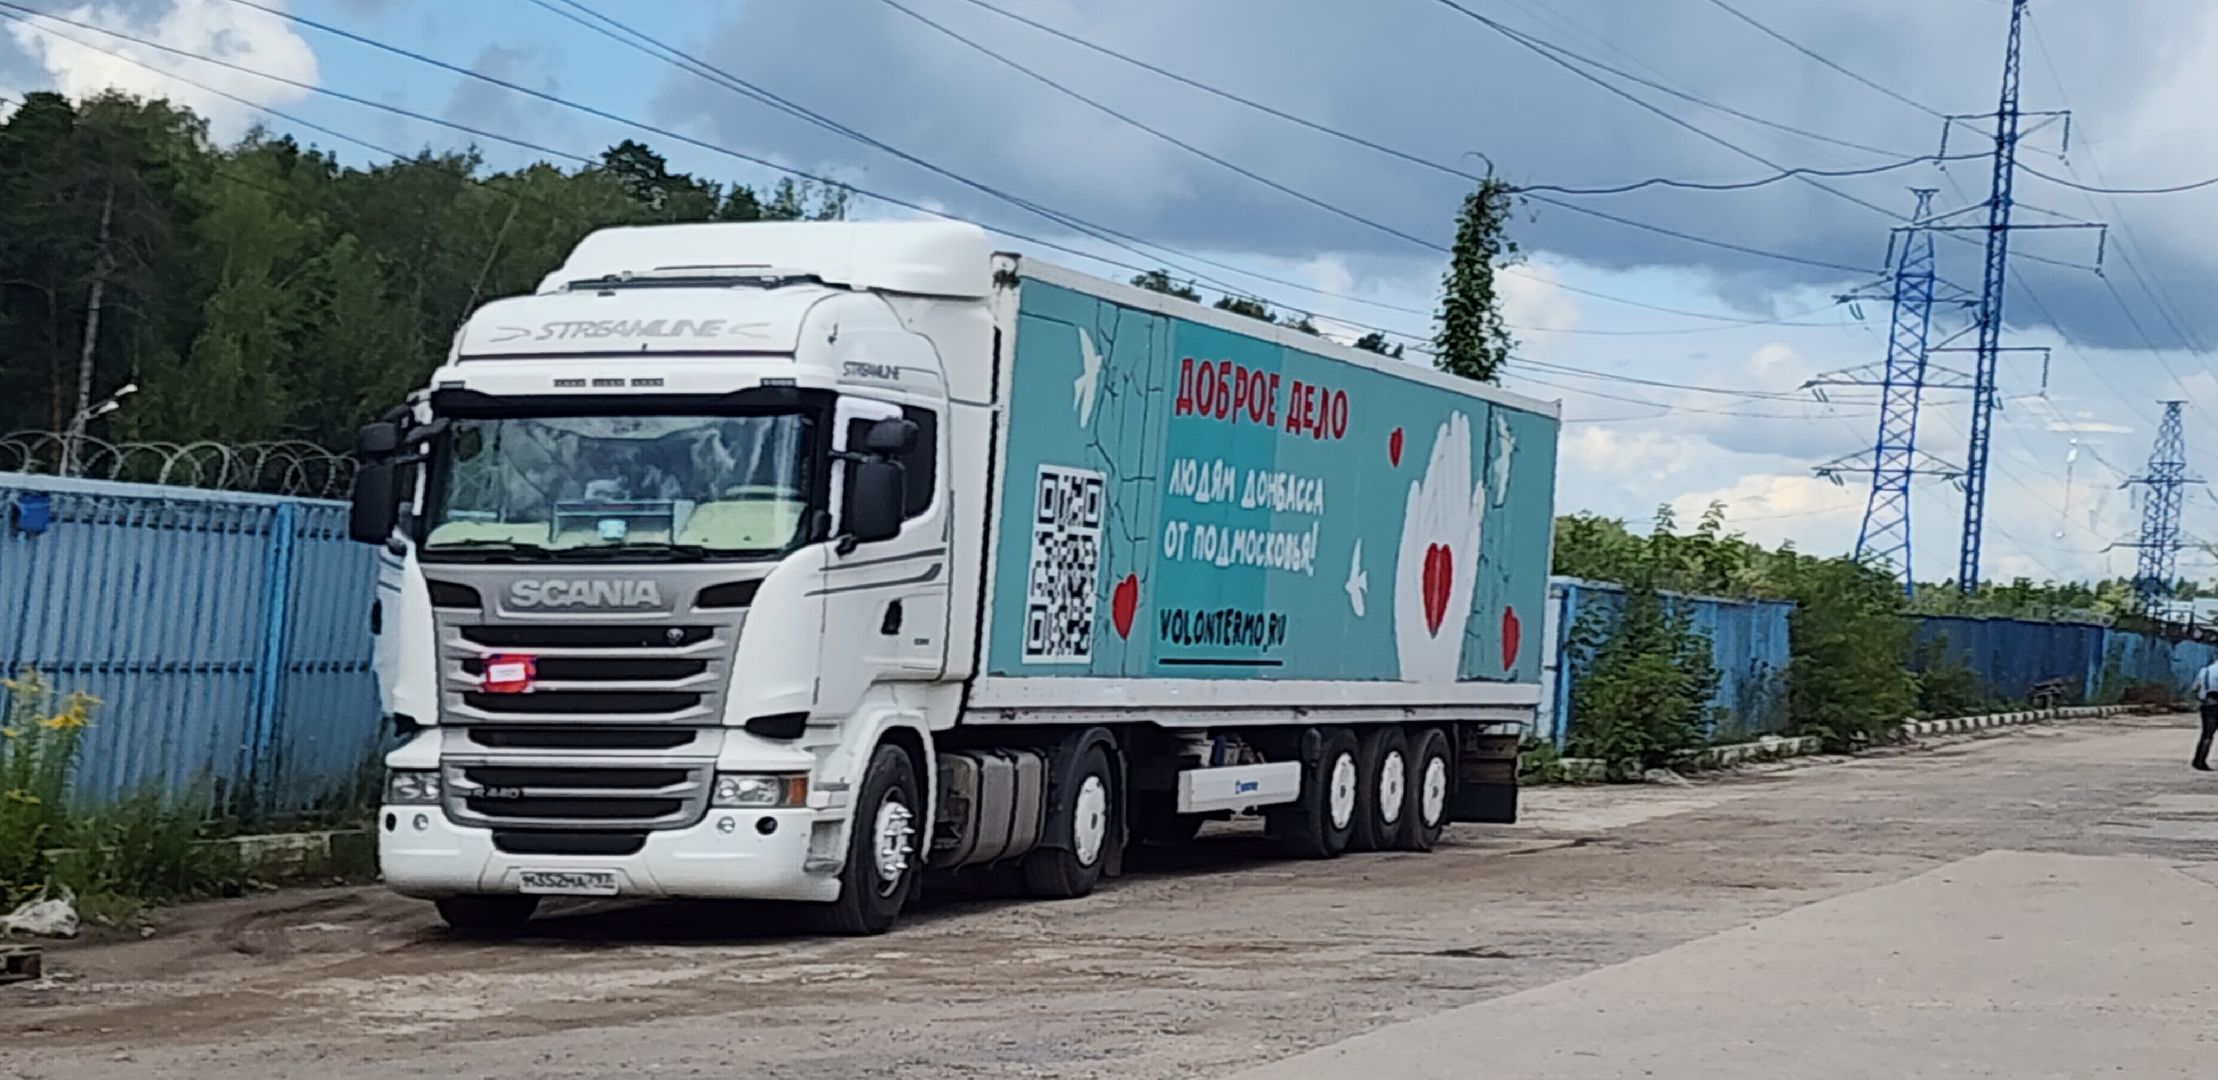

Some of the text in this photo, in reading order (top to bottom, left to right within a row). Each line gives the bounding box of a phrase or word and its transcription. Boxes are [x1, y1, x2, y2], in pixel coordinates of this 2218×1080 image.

[535, 319, 727, 341] STREAMLINE
[1175, 357, 1348, 440] ДОБРОЕ ДЕЛО
[1169, 458, 1324, 516] ЛЮДЯМ ДОНБАССА
[1163, 520, 1319, 577] ОТ ПОДМОСКОВЬЯ!
[510, 579, 662, 607] SCANIA
[1160, 608, 1287, 652] VOLONTERMO.RU
